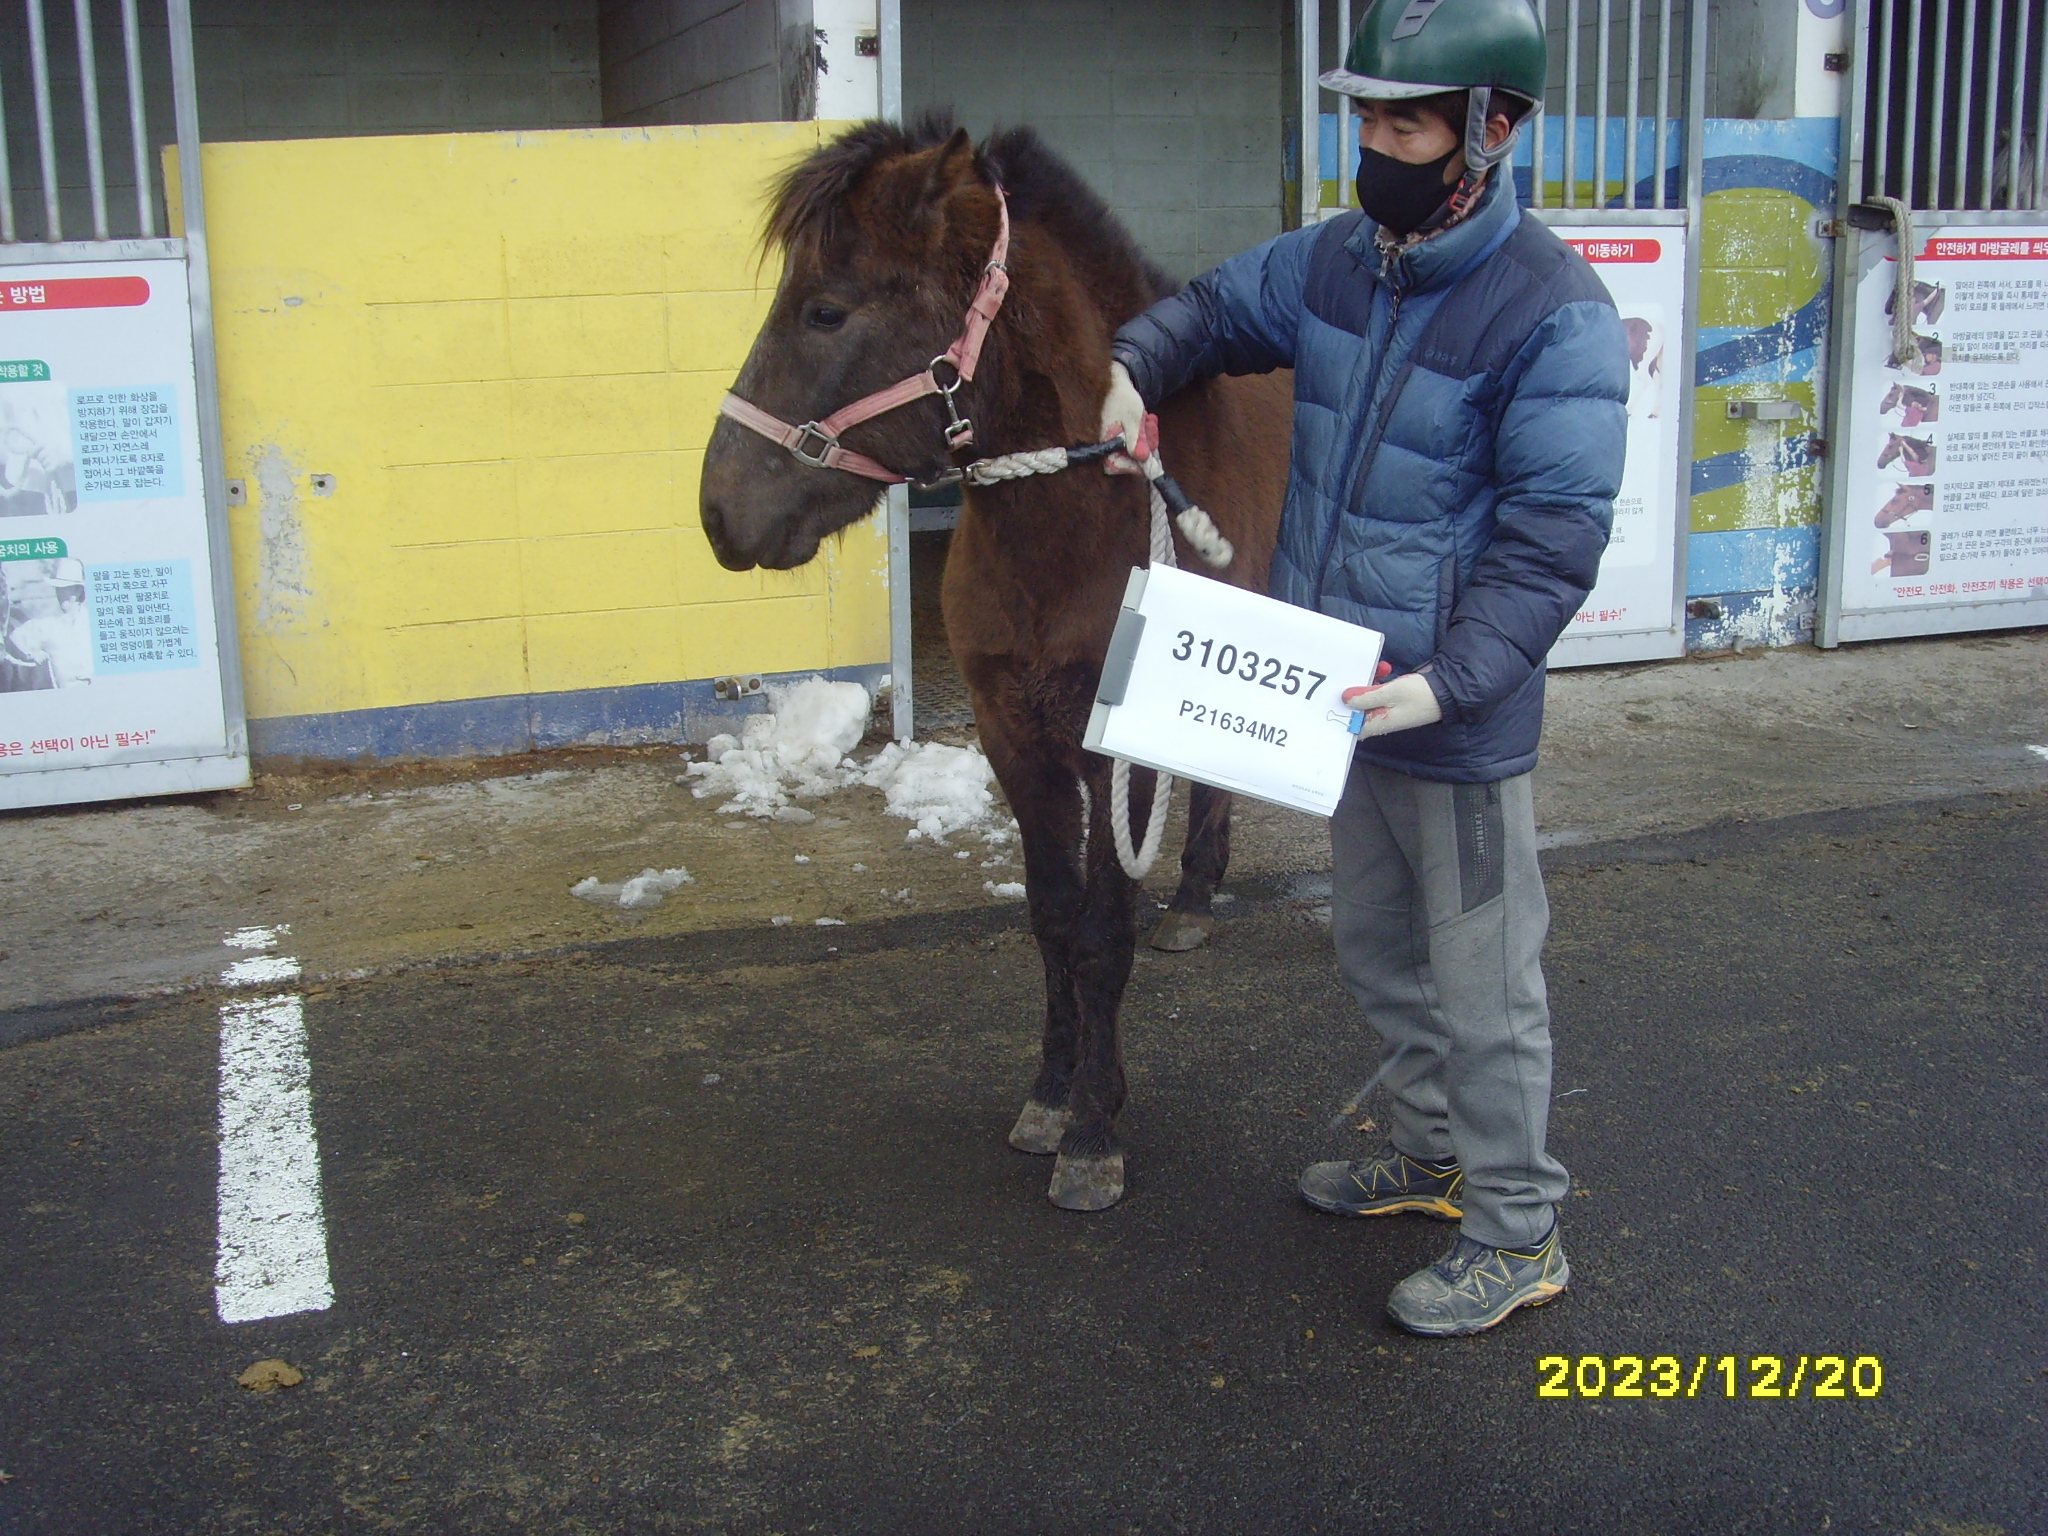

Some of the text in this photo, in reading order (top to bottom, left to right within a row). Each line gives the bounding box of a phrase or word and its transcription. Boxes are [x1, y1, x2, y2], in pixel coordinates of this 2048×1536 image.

[1588, 244, 1633, 258] 이동하기
[1936, 242, 2029, 255] 안전하게 마방굴레를
[2015, 280, 2033, 288] 로프를
[10, 285, 45, 304] 방법
[1955, 292, 1974, 300] 이렇게
[2042, 291, 2047, 299] 수
[1954, 303, 1967, 311] 말이
[1969, 303, 1988, 311] 로프를
[1967, 342, 1979, 351] 말이
[2020, 341, 2037, 349] 머리를
[32, 364, 43, 376] 것
[1929, 383, 1936, 395] 3
[1977, 382, 1989, 390] 있는
[76, 392, 157, 404] 로프로 인한 화상을
[78, 404, 167, 417] 방지하기 위해 장갑을
[79, 415, 172, 429] 착용한다. 말이 갑자기
[80, 429, 157, 441] 내달으면 손안에서
[1926, 433, 1933, 446] 4
[82, 442, 149, 453] 로프가 자연스레
[82, 453, 165, 466] 빠져나가도록 8자로
[84, 468, 111, 478] 접어서
[128, 465, 163, 475] 바깥쪽을
[85, 477, 164, 491] 손가락으로 잡는다.
[1923, 484, 1931, 496] 5
[1920, 533, 1928, 546] 6
[34, 541, 58, 554] 사용
[2023, 548, 2029, 556] 수
[93, 571, 110, 581] 말을
[113, 570, 130, 579] 끄는
[156, 566, 172, 576] 말이
[94, 579, 168, 592] 유도자 쪽으로 자꾸
[1962, 580, 1996, 592] 안전조끼
[2000, 578, 2024, 590] 착용은
[96, 591, 169, 604] 다가서면 팔꿈치로
[96, 603, 172, 616] 말의 목을 밀어낸다.
[98, 614, 170, 628] 왼손에 긴 회초리를
[1575, 611, 1595, 623] 아닌
[100, 625, 189, 640] 들고 움직이지 않으려는
[100, 637, 181, 652] 말의 엉덩이를 가볍게
[102, 648, 197, 664] 자극해서 재촉할 수 있다.
[1172, 630, 1327, 701] 3103257
[1179, 699, 1288, 747] P21634M2
[30, 738, 74, 754] 선택이
[80, 734, 109, 749] 아닌
